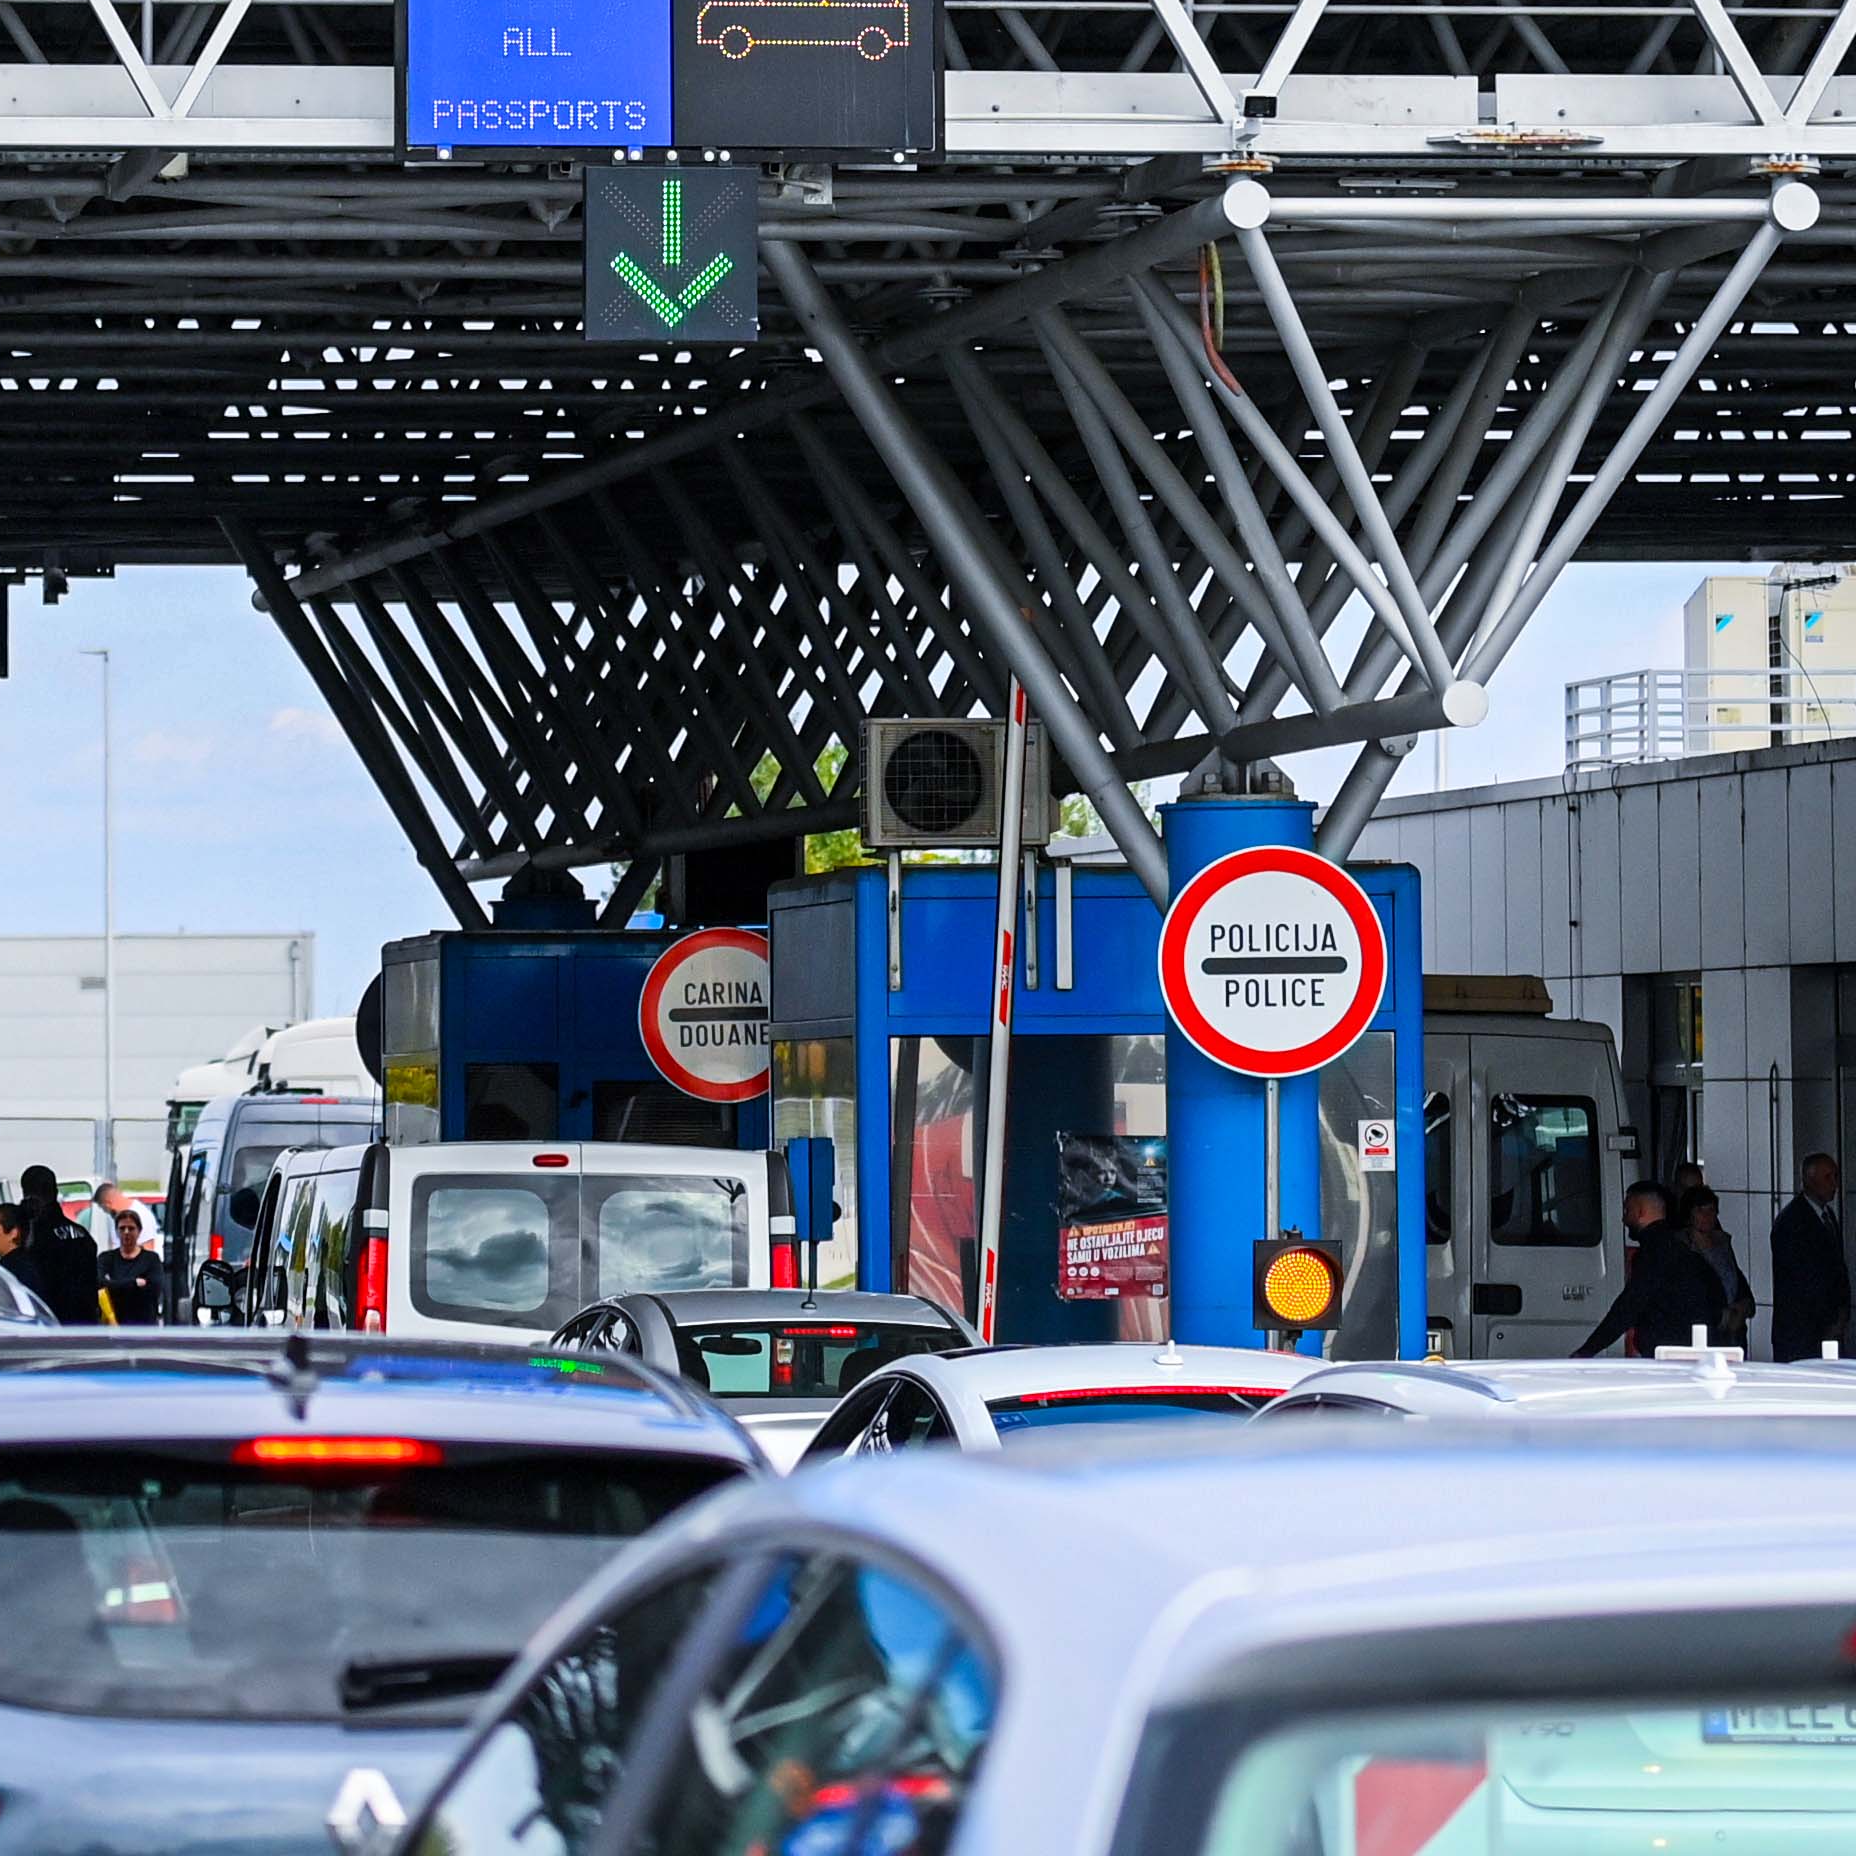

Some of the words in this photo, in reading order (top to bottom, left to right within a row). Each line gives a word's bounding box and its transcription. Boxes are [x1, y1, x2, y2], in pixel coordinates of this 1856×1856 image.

[503, 26, 572, 57] ALL
[432, 99, 647, 131] PASSPORTS
[1210, 923, 1337, 952] POLICIJA
[684, 981, 762, 1005] CARINA
[1225, 978, 1325, 1008] POLICE
[680, 1023, 769, 1048] DOUANE
[1067, 1238, 1078, 1251] NE
[1079, 1231, 1136, 1250] OSTAVLJAJTE
[1137, 1227, 1164, 1242] DJECU
[1067, 1249, 1091, 1265] SAMU
[1093, 1249, 1100, 1262] U
[1102, 1243, 1146, 1261] VOZILIMA
